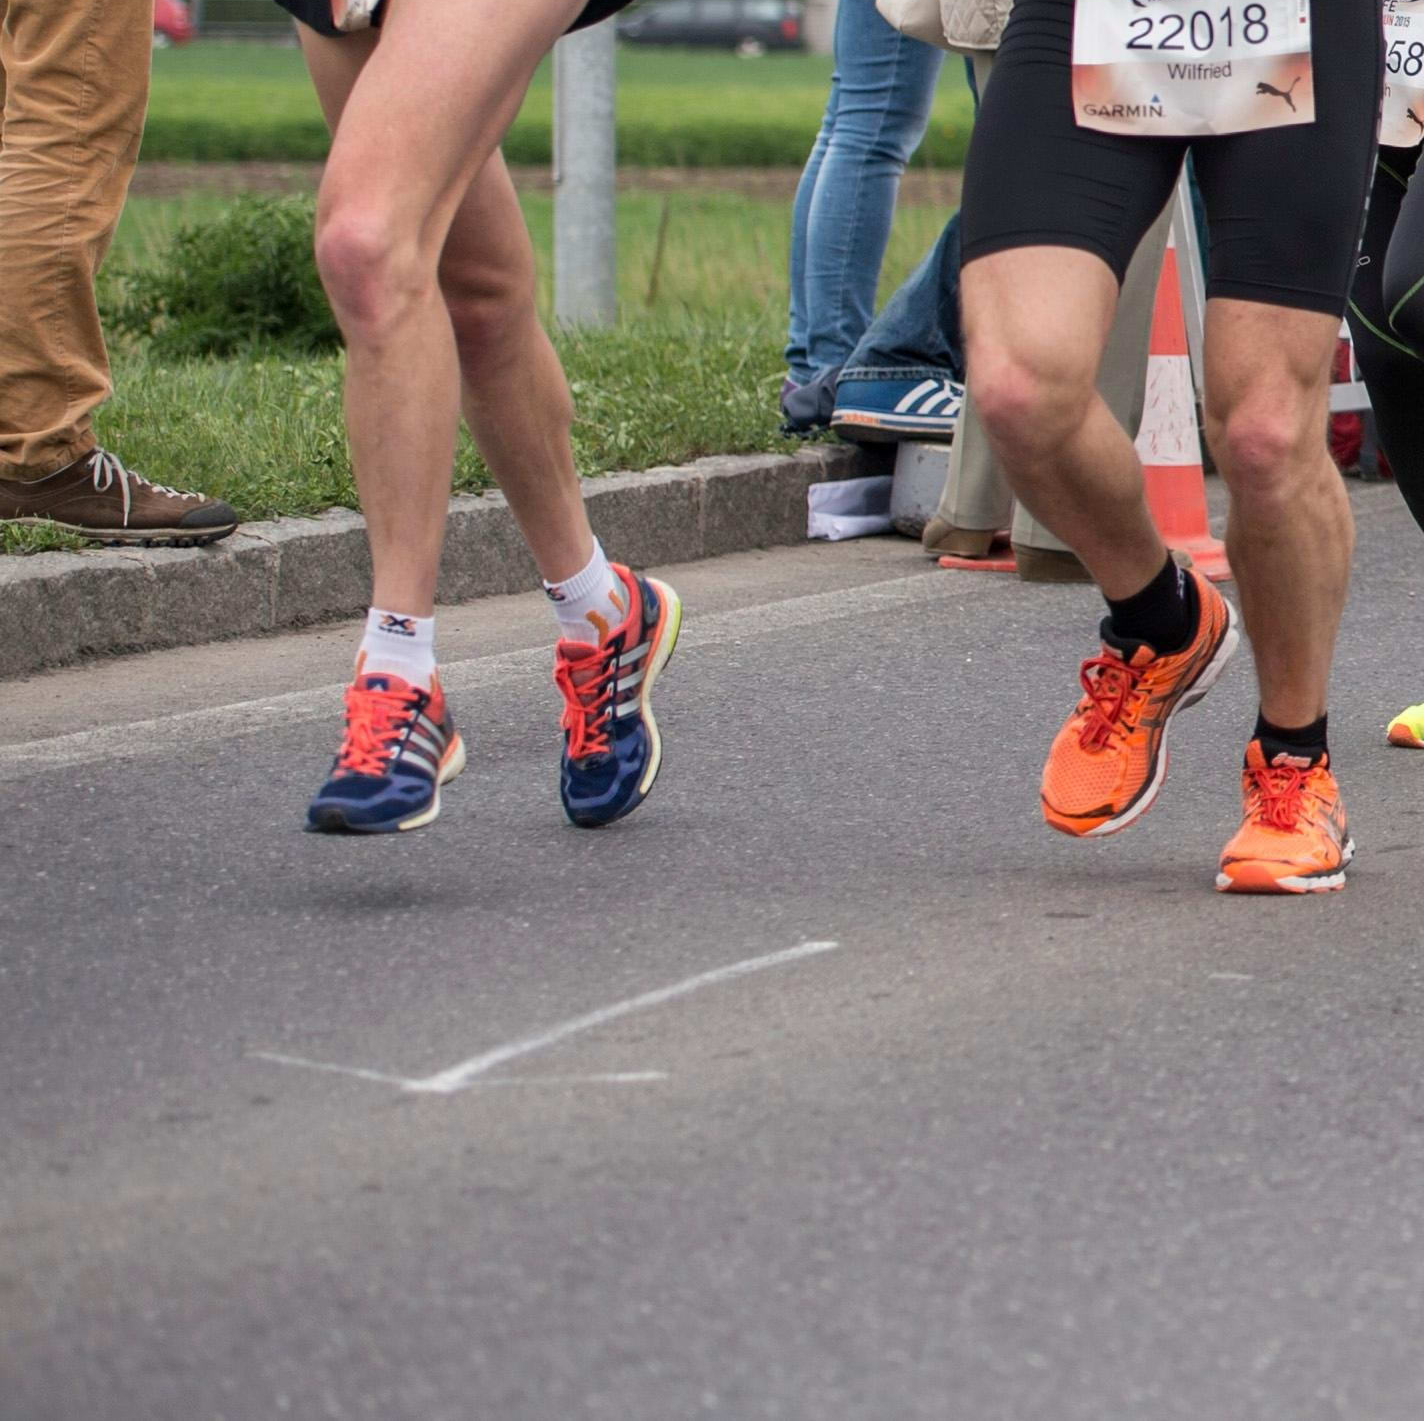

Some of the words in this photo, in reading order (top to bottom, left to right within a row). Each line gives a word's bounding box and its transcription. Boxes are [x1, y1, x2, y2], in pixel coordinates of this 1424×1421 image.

[1125, 3, 1270, 51] 22018
[1394, 14, 1411, 28] 2015
[1386, 40, 1424, 77] 58
[1166, 61, 1233, 81] Wilfried
[1082, 103, 1165, 119] GARMIN
